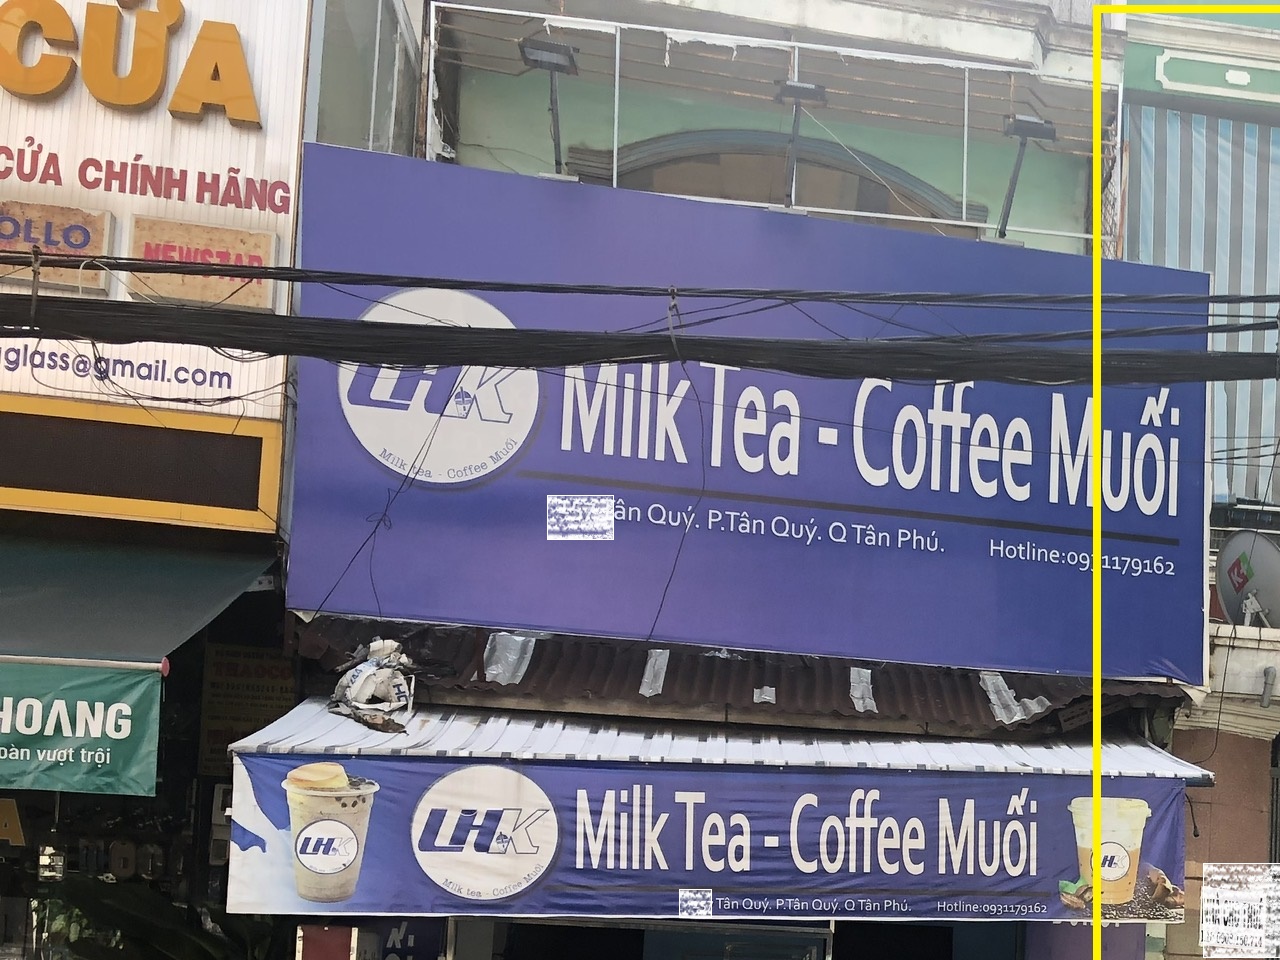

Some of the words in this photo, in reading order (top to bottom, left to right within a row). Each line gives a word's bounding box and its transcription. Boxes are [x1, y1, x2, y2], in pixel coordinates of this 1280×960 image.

[78, 154, 188, 201] CHÍNH
[195, 167, 291, 214] HÃNG
[0, 343, 232, 389] glass@gmail.com
[561, 361, 691, 463] Milk
[700, 362, 800, 476] Tea
[852, 376, 1033, 502] Coffee
[1048, 386, 1180, 517] Muối
[379, 447, 408, 471] Milk
[446, 460, 489, 479] Coffee
[613, 501, 641, 523] ân
[647, 503, 700, 533] Quý.
[708, 509, 766, 536] P.Tân
[771, 516, 822, 546] Quý.
[828, 521, 848, 545] Q
[852, 524, 891, 548] Tân
[898, 527, 945, 553] Phú.
[36, 746, 75, 765] vượt
[80, 747, 111, 765] trội
[575, 784, 670, 871] Milk
[673, 790, 751, 873] Tea
[790, 787, 926, 876] Coffee
[938, 786, 1038, 878] Muối
[442, 878, 464, 894] Milk
[492, 881, 523, 897] Coffee
[742, 897, 773, 914] Quý.
[776, 896, 808, 912] P.Tân
[810, 898, 842, 915] Quý.
[844, 899, 856, 913] Q
[858, 898, 882, 912] Tân
[884, 899, 912, 913] Phú.
[936, 899, 1048, 916] Hotline:0931179162
